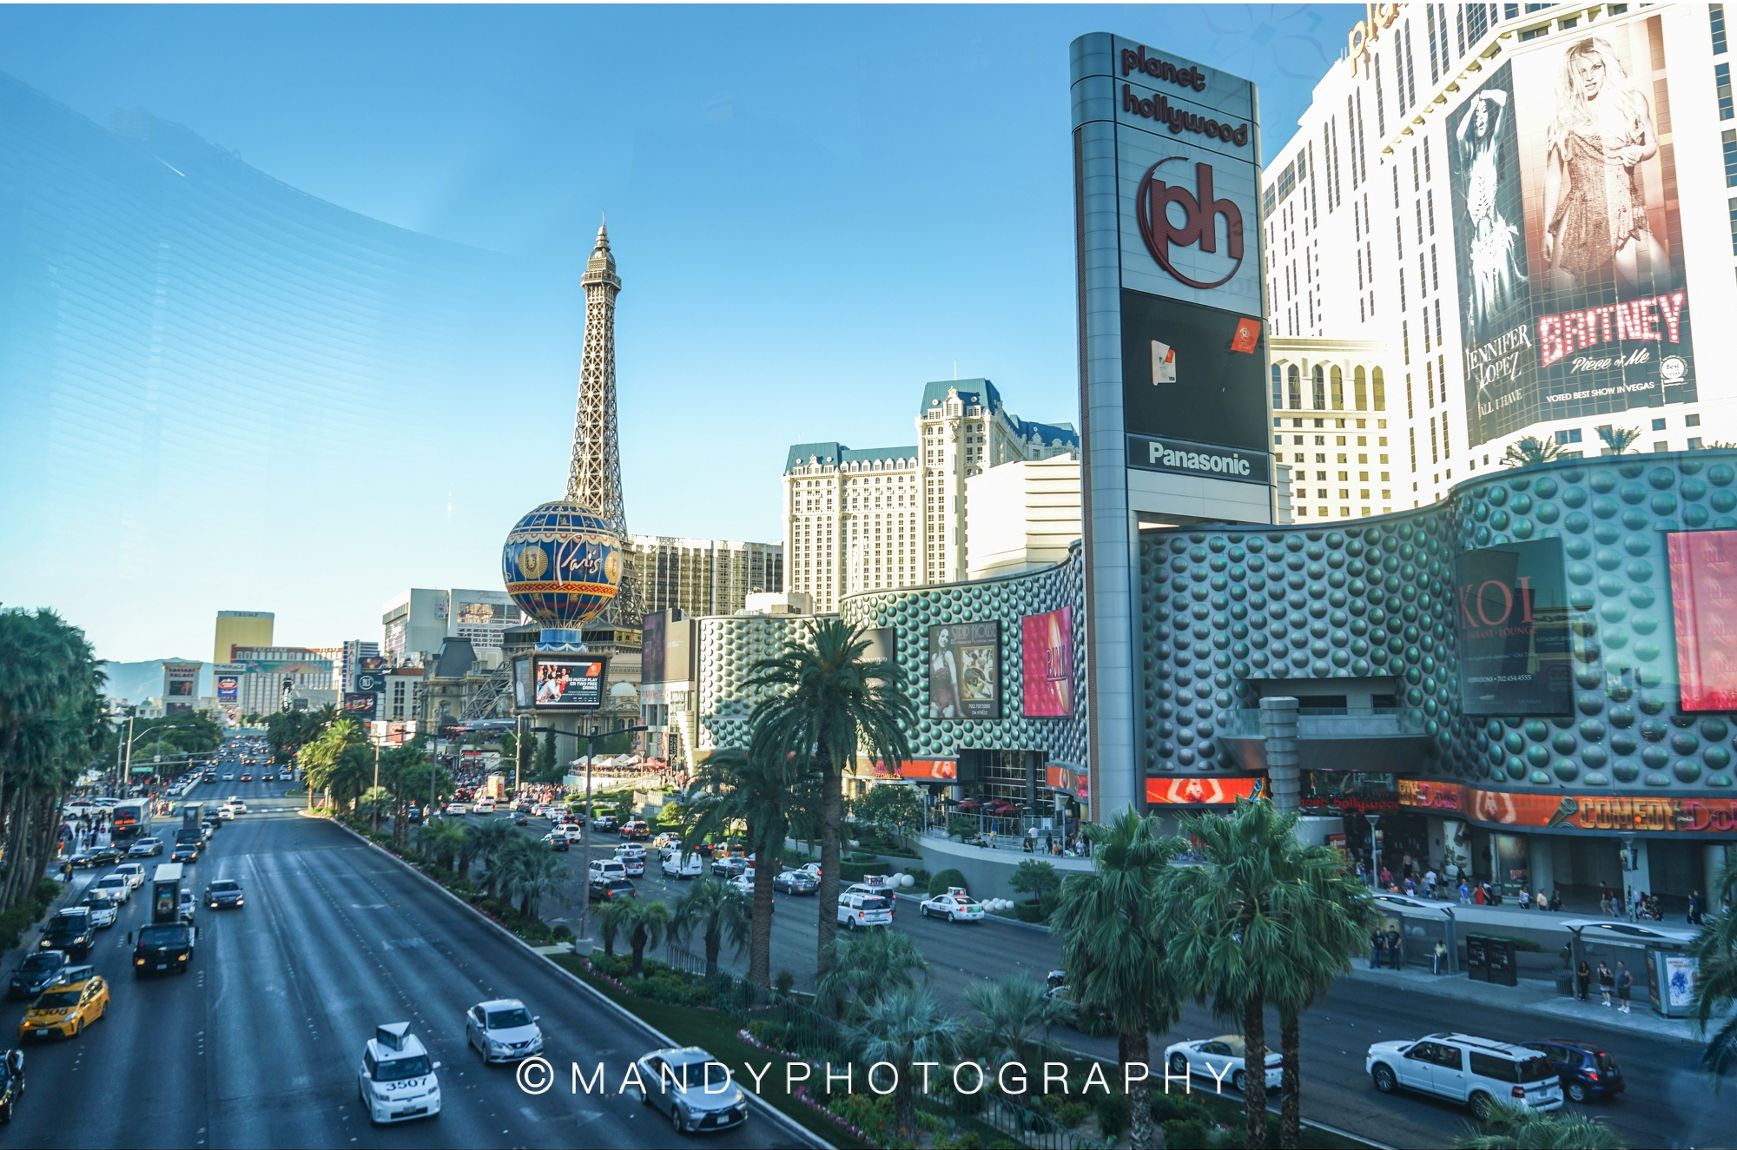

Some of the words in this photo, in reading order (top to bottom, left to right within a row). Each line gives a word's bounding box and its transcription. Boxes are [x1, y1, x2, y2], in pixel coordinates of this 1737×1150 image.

[1122, 46, 1205, 92] planet
[1122, 84, 1248, 148] hollywood
[1538, 291, 1686, 368] BRITNEY
[1466, 324, 1532, 380] JENNIFER
[1480, 352, 1522, 390] LOPEZ
[1571, 355, 1612, 374] Piece
[1623, 347, 1650, 367] Me
[1546, 392, 1573, 403] VOTED
[1573, 390, 1592, 400] BEST
[1591, 387, 1616, 398] SHOW
[1616, 385, 1626, 394] IN
[1625, 381, 1655, 394] VEGAS
[1148, 441, 1251, 476] Panasonic
[555, 533, 602, 586] Paris
[1579, 796, 1676, 832] COMEDY
